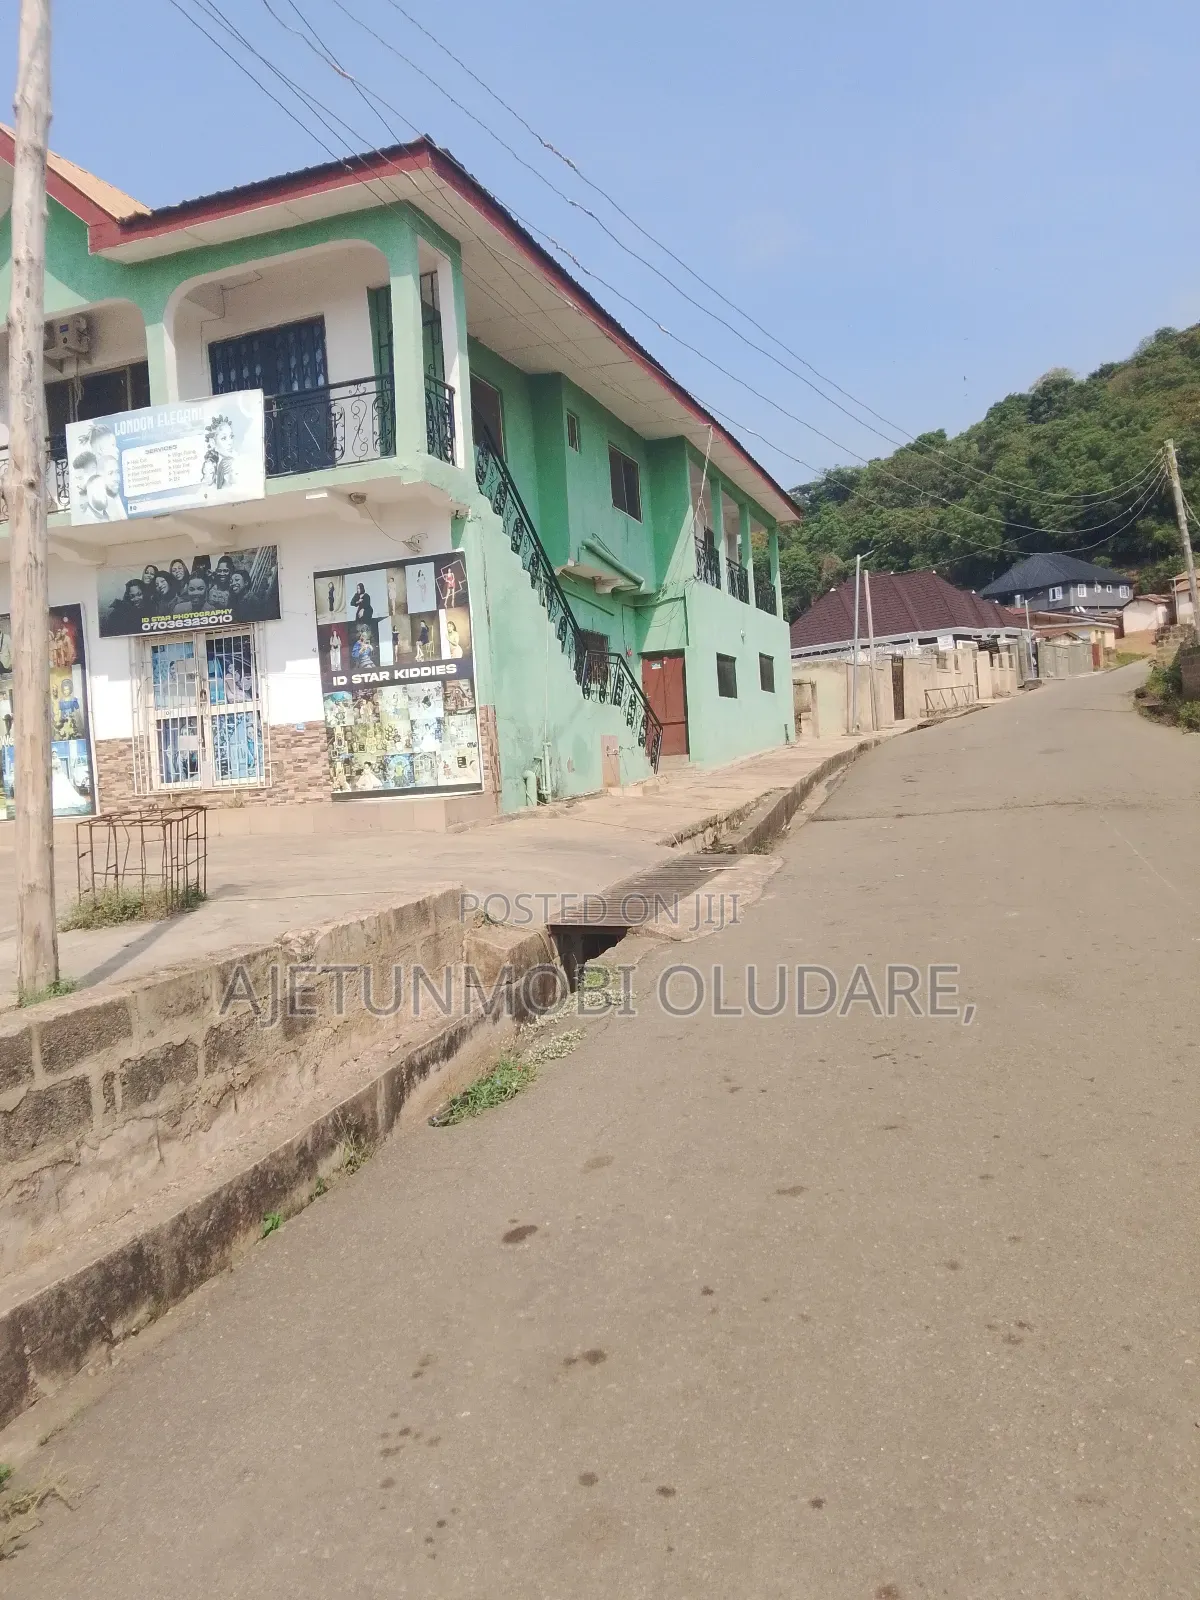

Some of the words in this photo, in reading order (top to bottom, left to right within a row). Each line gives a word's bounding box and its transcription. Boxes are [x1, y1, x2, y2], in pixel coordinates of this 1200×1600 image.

[114, 416, 154, 436] LONDON
[145, 444, 178, 455] SERVICES
[141, 614, 233, 631] 07036323010
[172, 608, 233, 620] PHOTOGRAPHY
[332, 676, 348, 687] ID
[351, 671, 390, 684] STAR
[394, 663, 458, 680] KIDDIES
